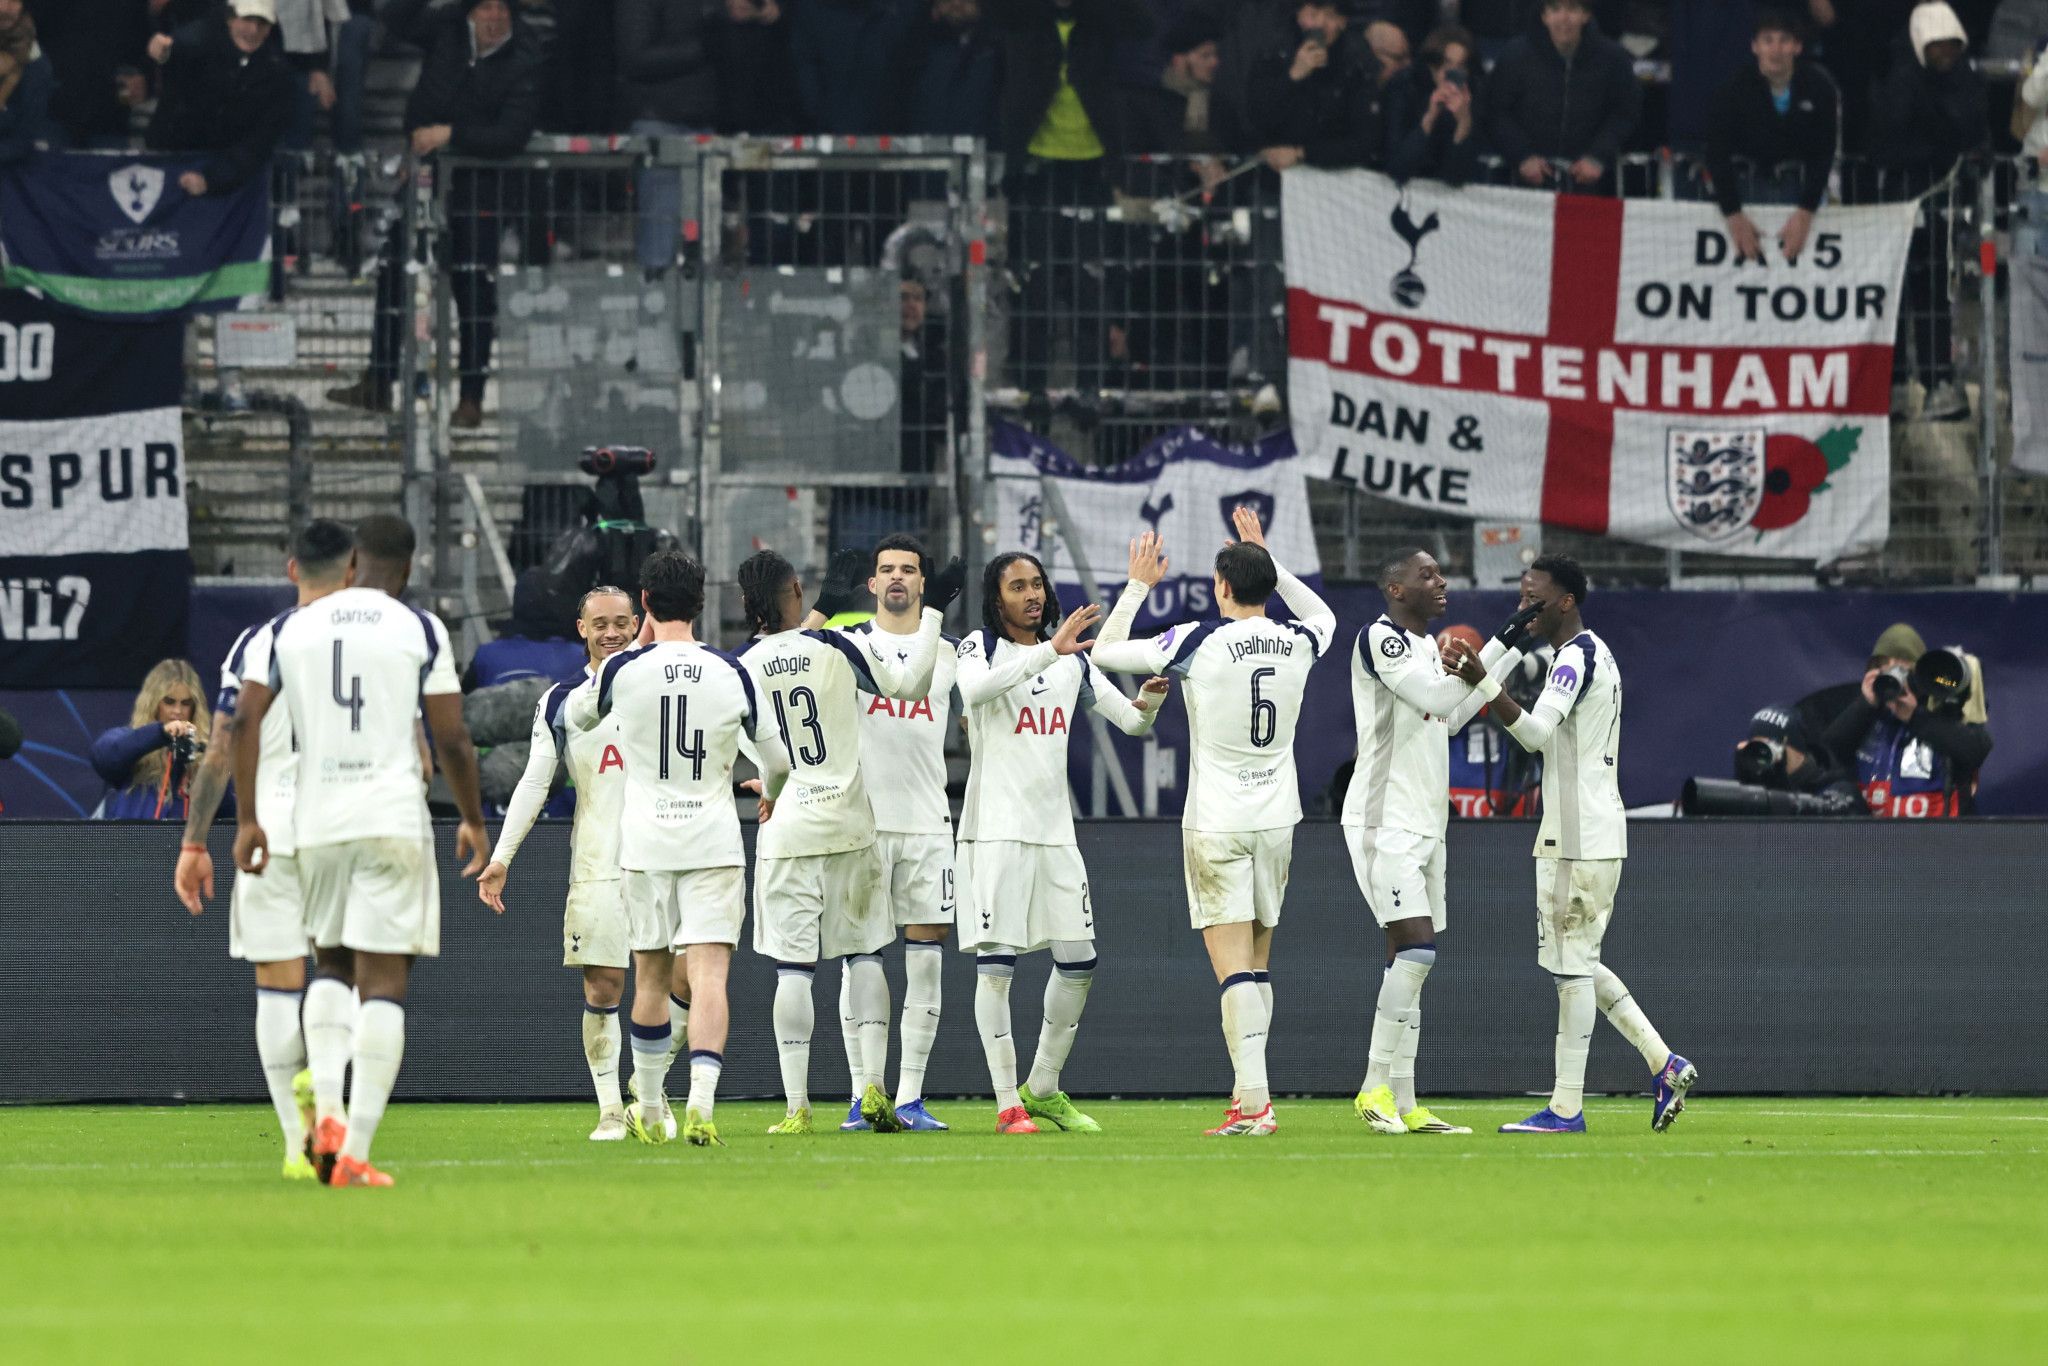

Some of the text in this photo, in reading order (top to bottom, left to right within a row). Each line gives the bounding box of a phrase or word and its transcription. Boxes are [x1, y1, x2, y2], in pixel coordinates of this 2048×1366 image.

[1636, 283, 1886, 322] ON TOUR
[1317, 304, 1849, 409] TOTTENHAM
[1330, 390, 1484, 453] DAN &
[1, 442, 179, 510] SPUR
[1331, 446, 1470, 505] LUKE
[331, 608, 382, 625] danso
[763, 654, 810, 677] udogie
[1227, 636, 1293, 663] j.palhinha
[333, 639, 364, 732] 4
[665, 663, 702, 683] gray
[867, 694, 934, 722] AIA
[1014, 706, 1067, 735] AIA
[1250, 667, 1276, 747] 6
[659, 695, 706, 780] 14
[772, 685, 827, 770] 13
[817, 792, 845, 803] FOREST
[942, 868, 954, 901] 19
